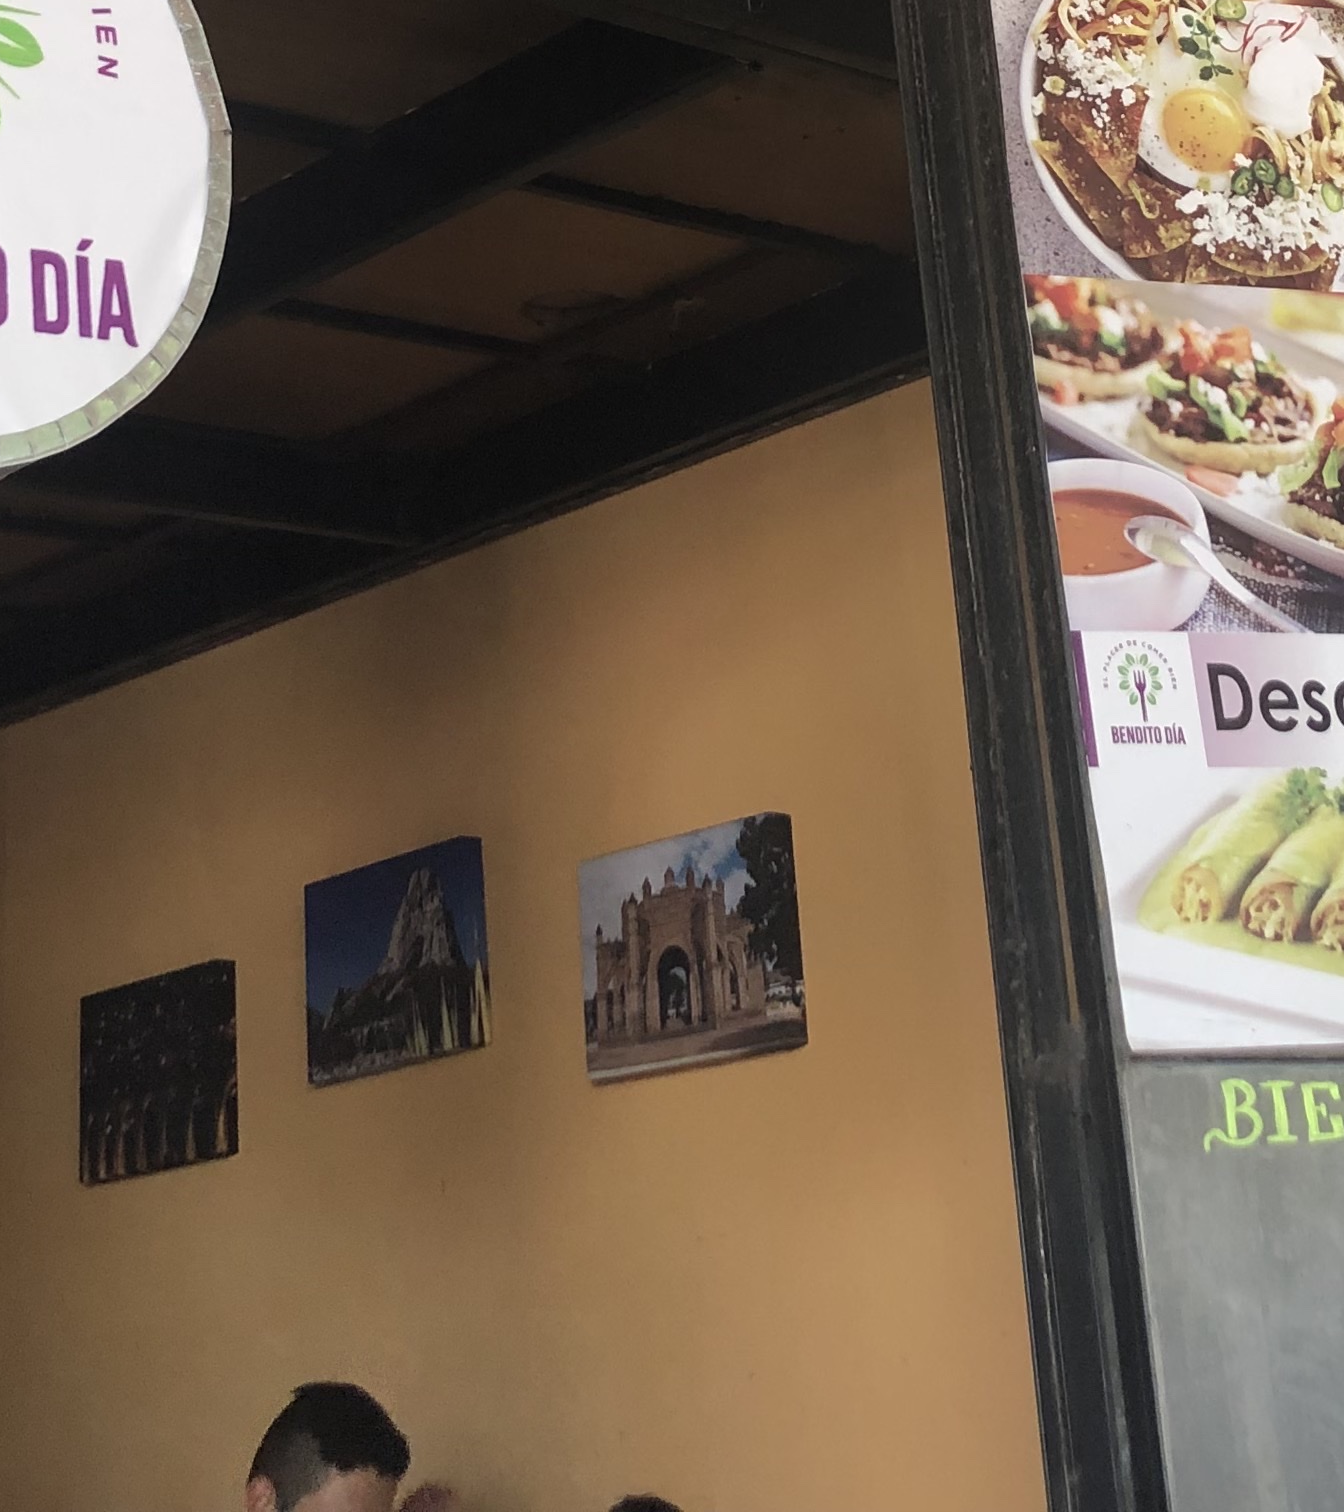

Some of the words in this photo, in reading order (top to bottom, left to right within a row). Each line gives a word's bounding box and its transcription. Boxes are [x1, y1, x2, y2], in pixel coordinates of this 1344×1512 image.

[30, 238, 139, 348] DÍA
[1110, 726, 1162, 744] BENDITO
[1164, 722, 1186, 745] DÍA
